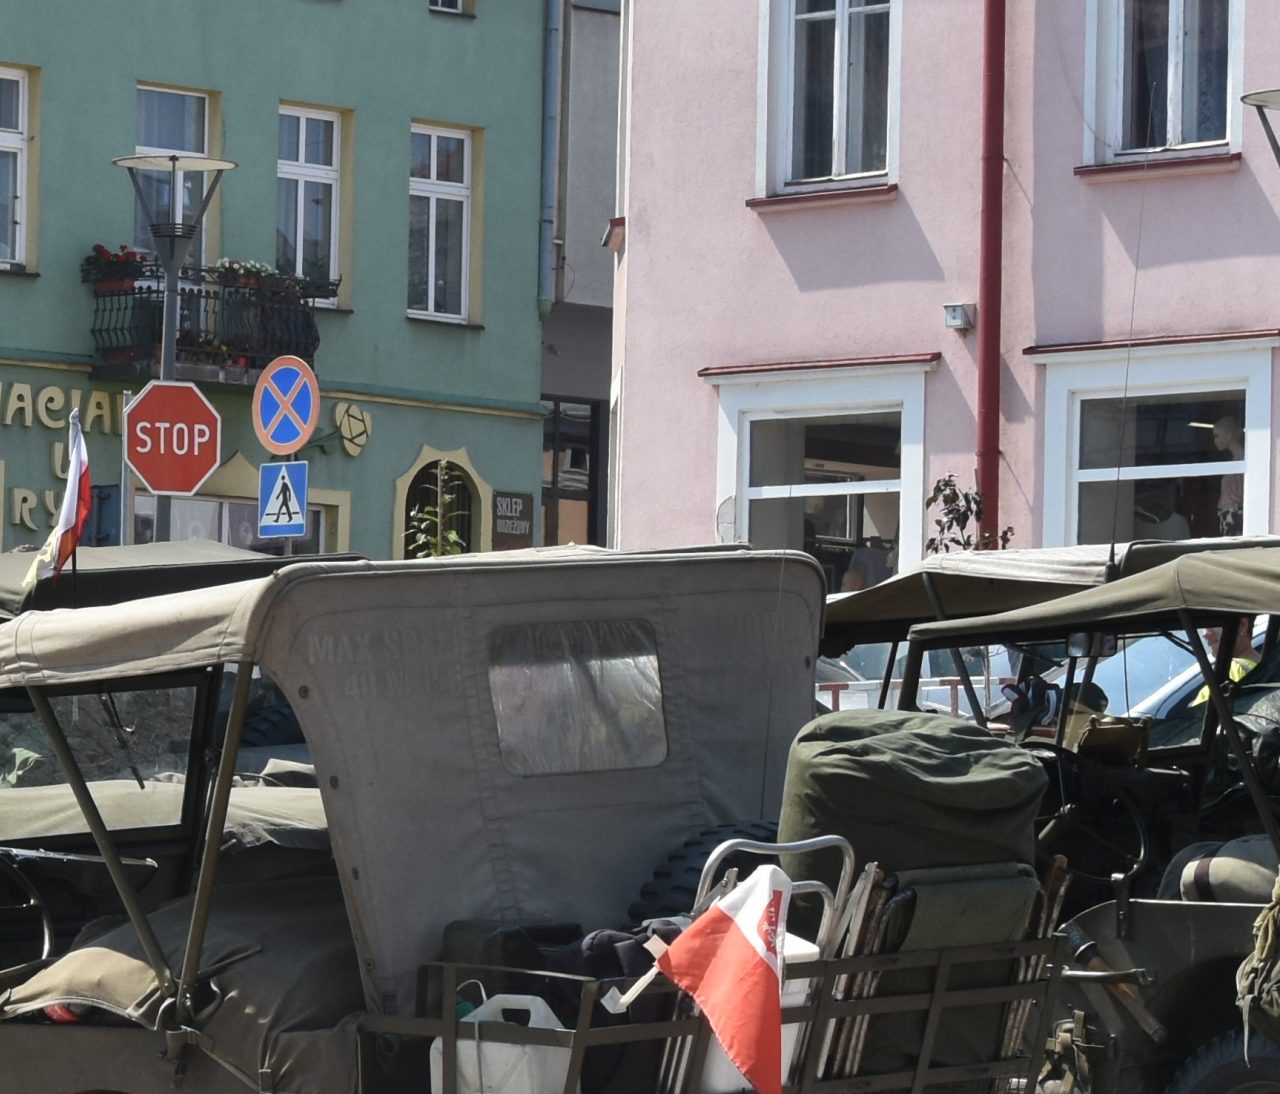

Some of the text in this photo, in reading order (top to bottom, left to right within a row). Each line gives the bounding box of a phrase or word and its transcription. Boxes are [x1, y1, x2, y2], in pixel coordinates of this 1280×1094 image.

[135, 421, 210, 455] STOP
[496, 496, 523, 517] SKLEP
[308, 631, 373, 665] MAX
